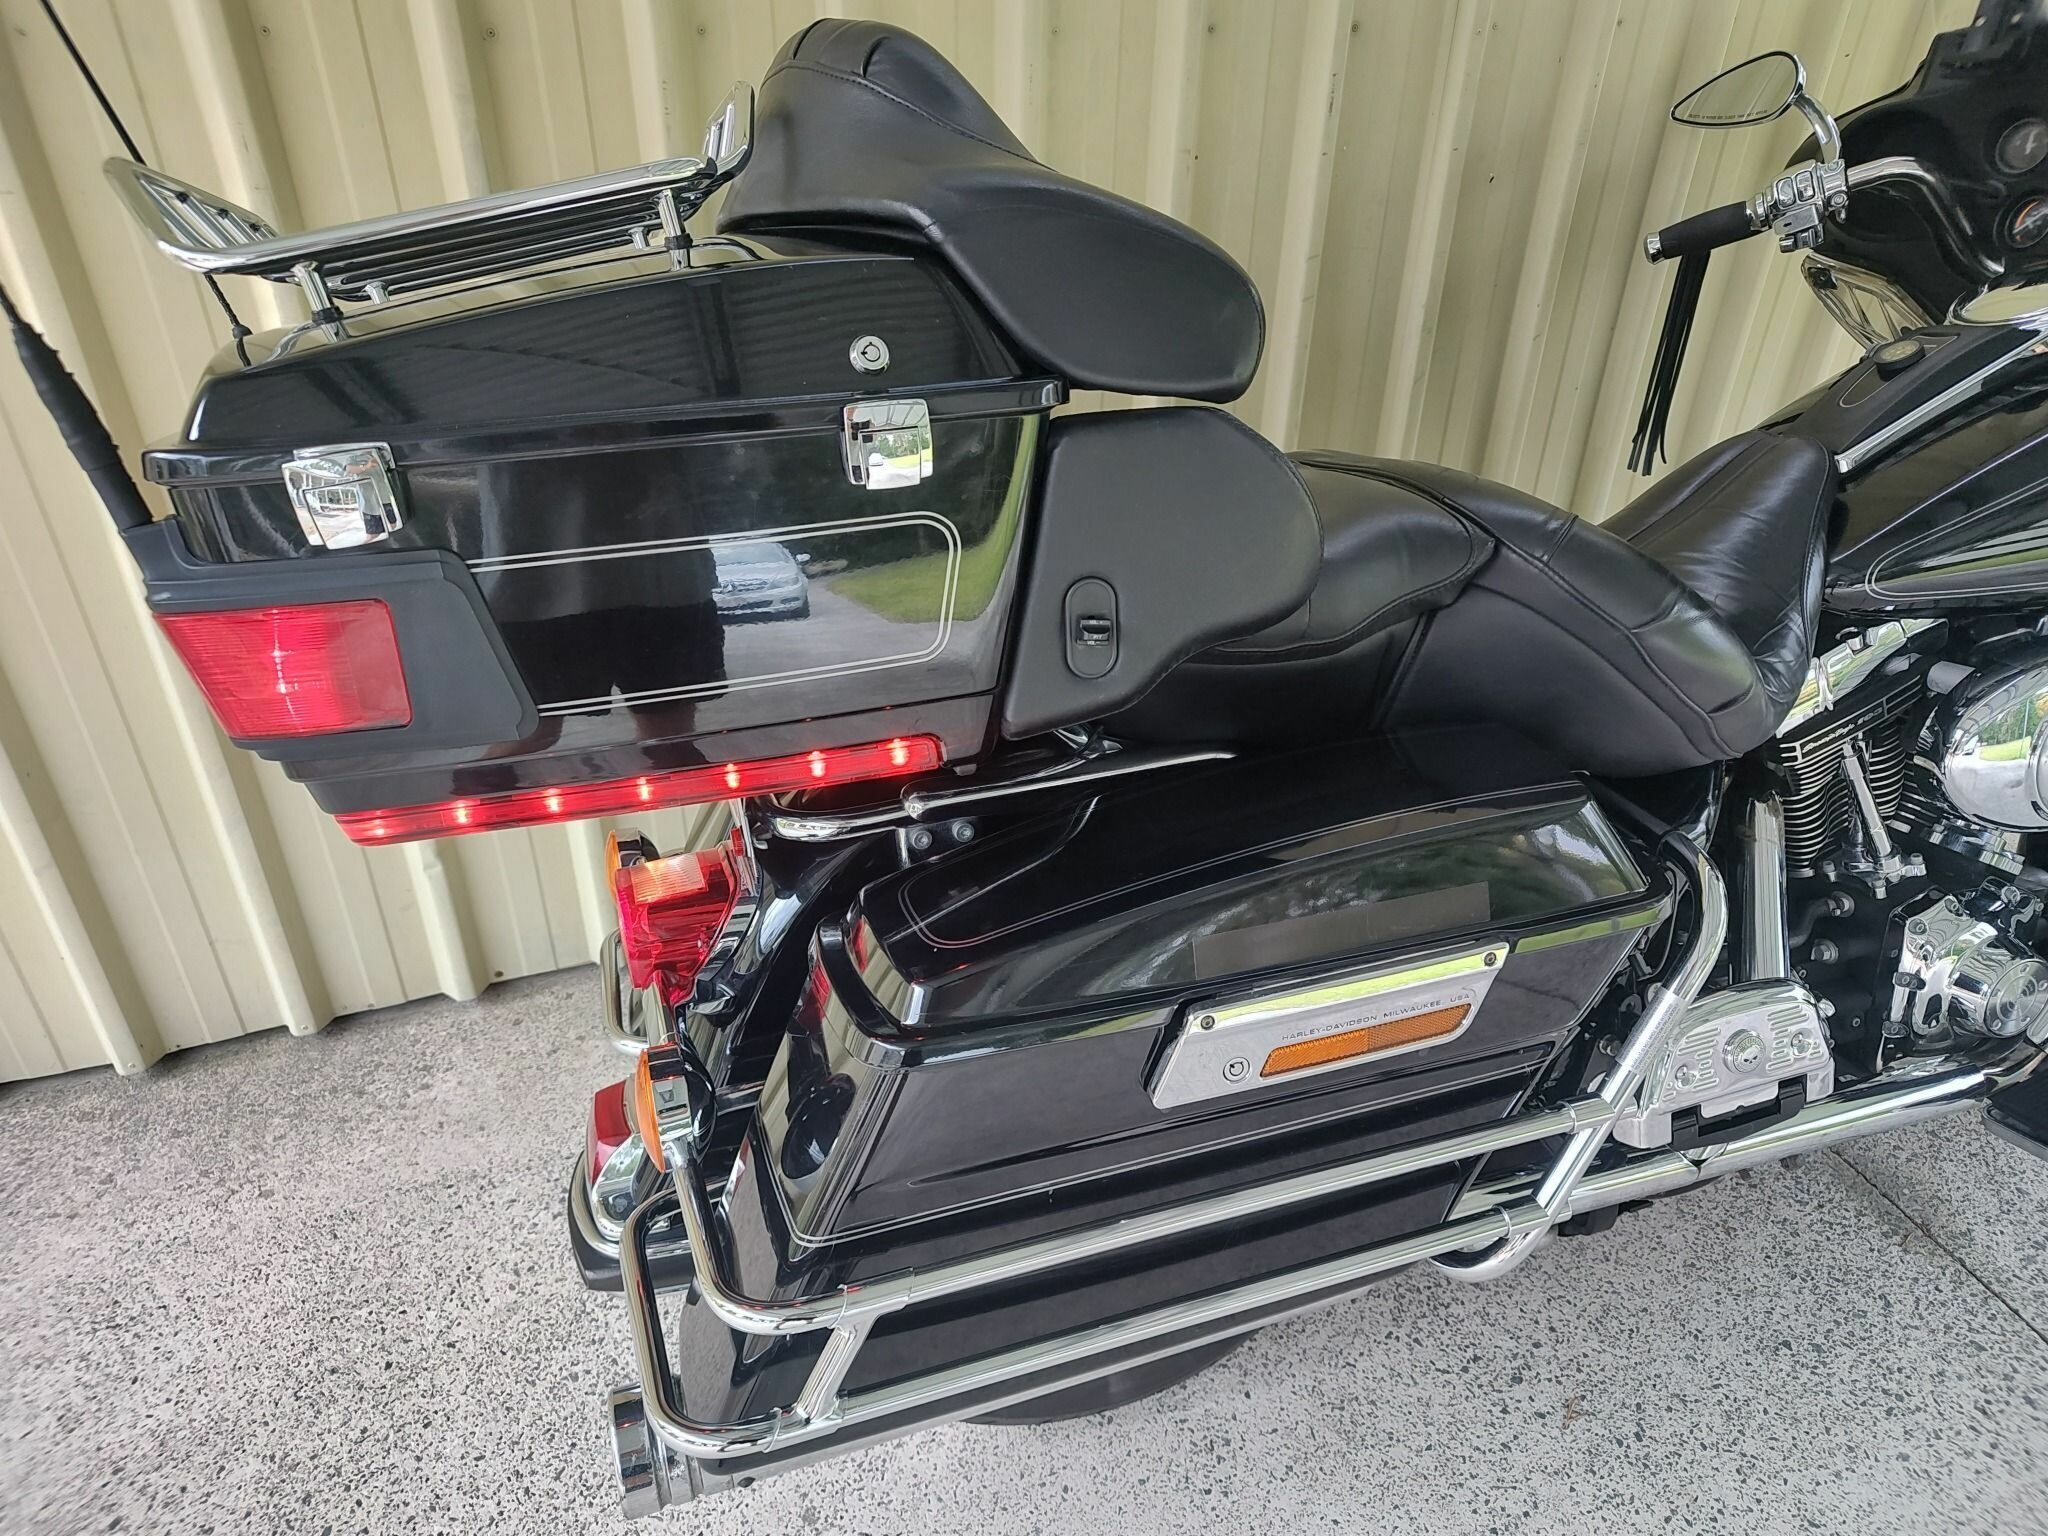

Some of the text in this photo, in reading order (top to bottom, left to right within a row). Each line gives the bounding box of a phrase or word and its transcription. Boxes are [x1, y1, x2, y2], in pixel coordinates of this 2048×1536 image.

[1281, 993, 1470, 1041] HARLEY-DAVIDSON MILWAUKEE USA
